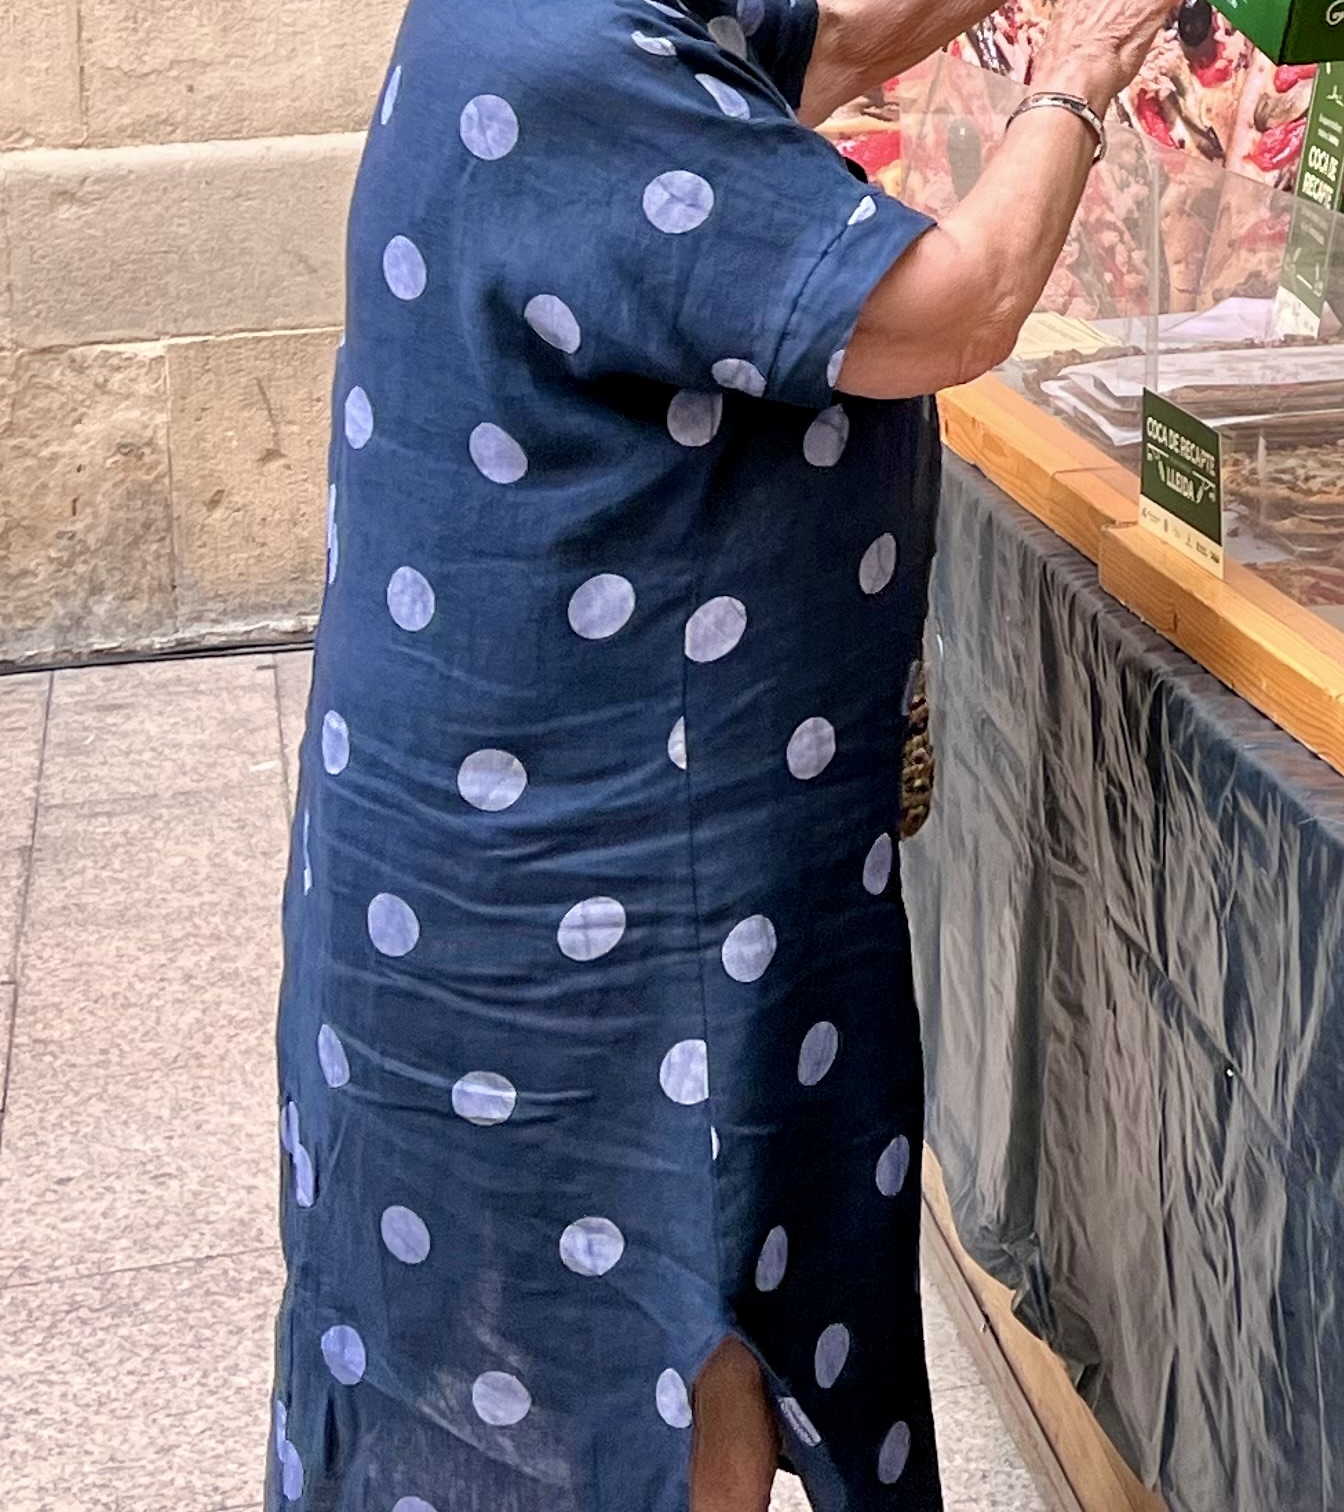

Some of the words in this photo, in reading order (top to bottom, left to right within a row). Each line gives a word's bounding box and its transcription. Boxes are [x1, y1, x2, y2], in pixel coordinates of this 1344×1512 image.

[1146, 416, 1168, 448] COCA
[1168, 429, 1180, 454] DE
[1180, 436, 1216, 477] RECAPTE
[1166, 466, 1196, 504] LLEIDA
